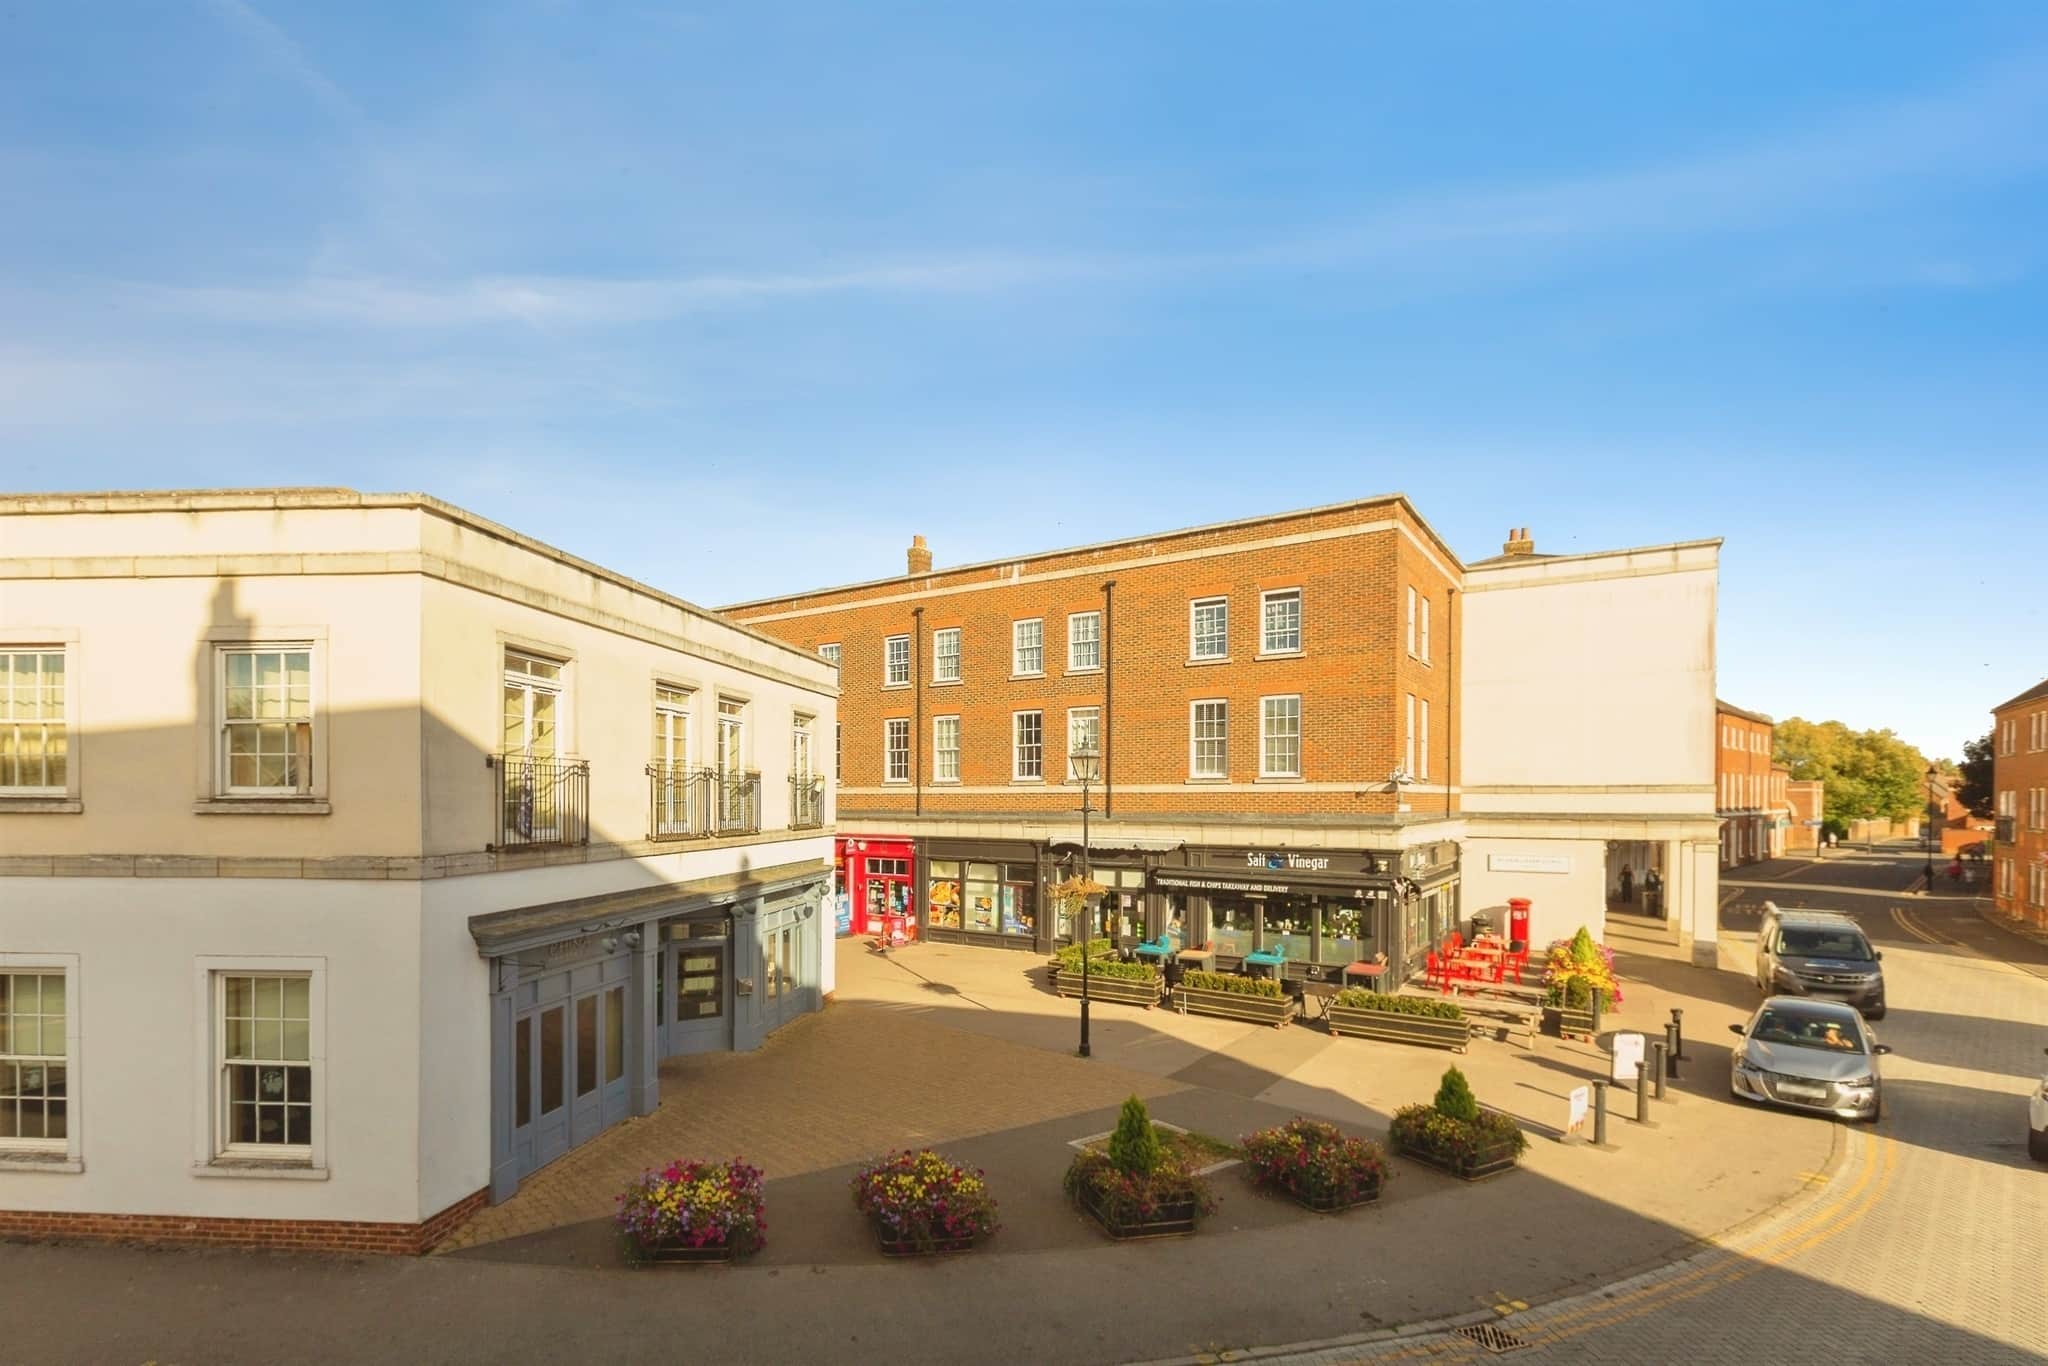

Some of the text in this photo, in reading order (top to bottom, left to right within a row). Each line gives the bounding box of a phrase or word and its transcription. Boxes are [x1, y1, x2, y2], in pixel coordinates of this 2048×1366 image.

[1247, 852, 1329, 871] Salt Vinegar
[1157, 878, 1189, 887] TRADITIONAL
[1189, 880, 1200, 888] FISH
[1206, 881, 1221, 889] CHIPS
[1222, 882, 1249, 891] TAKEAWAY
[1263, 885, 1289, 893] DELIVERY
